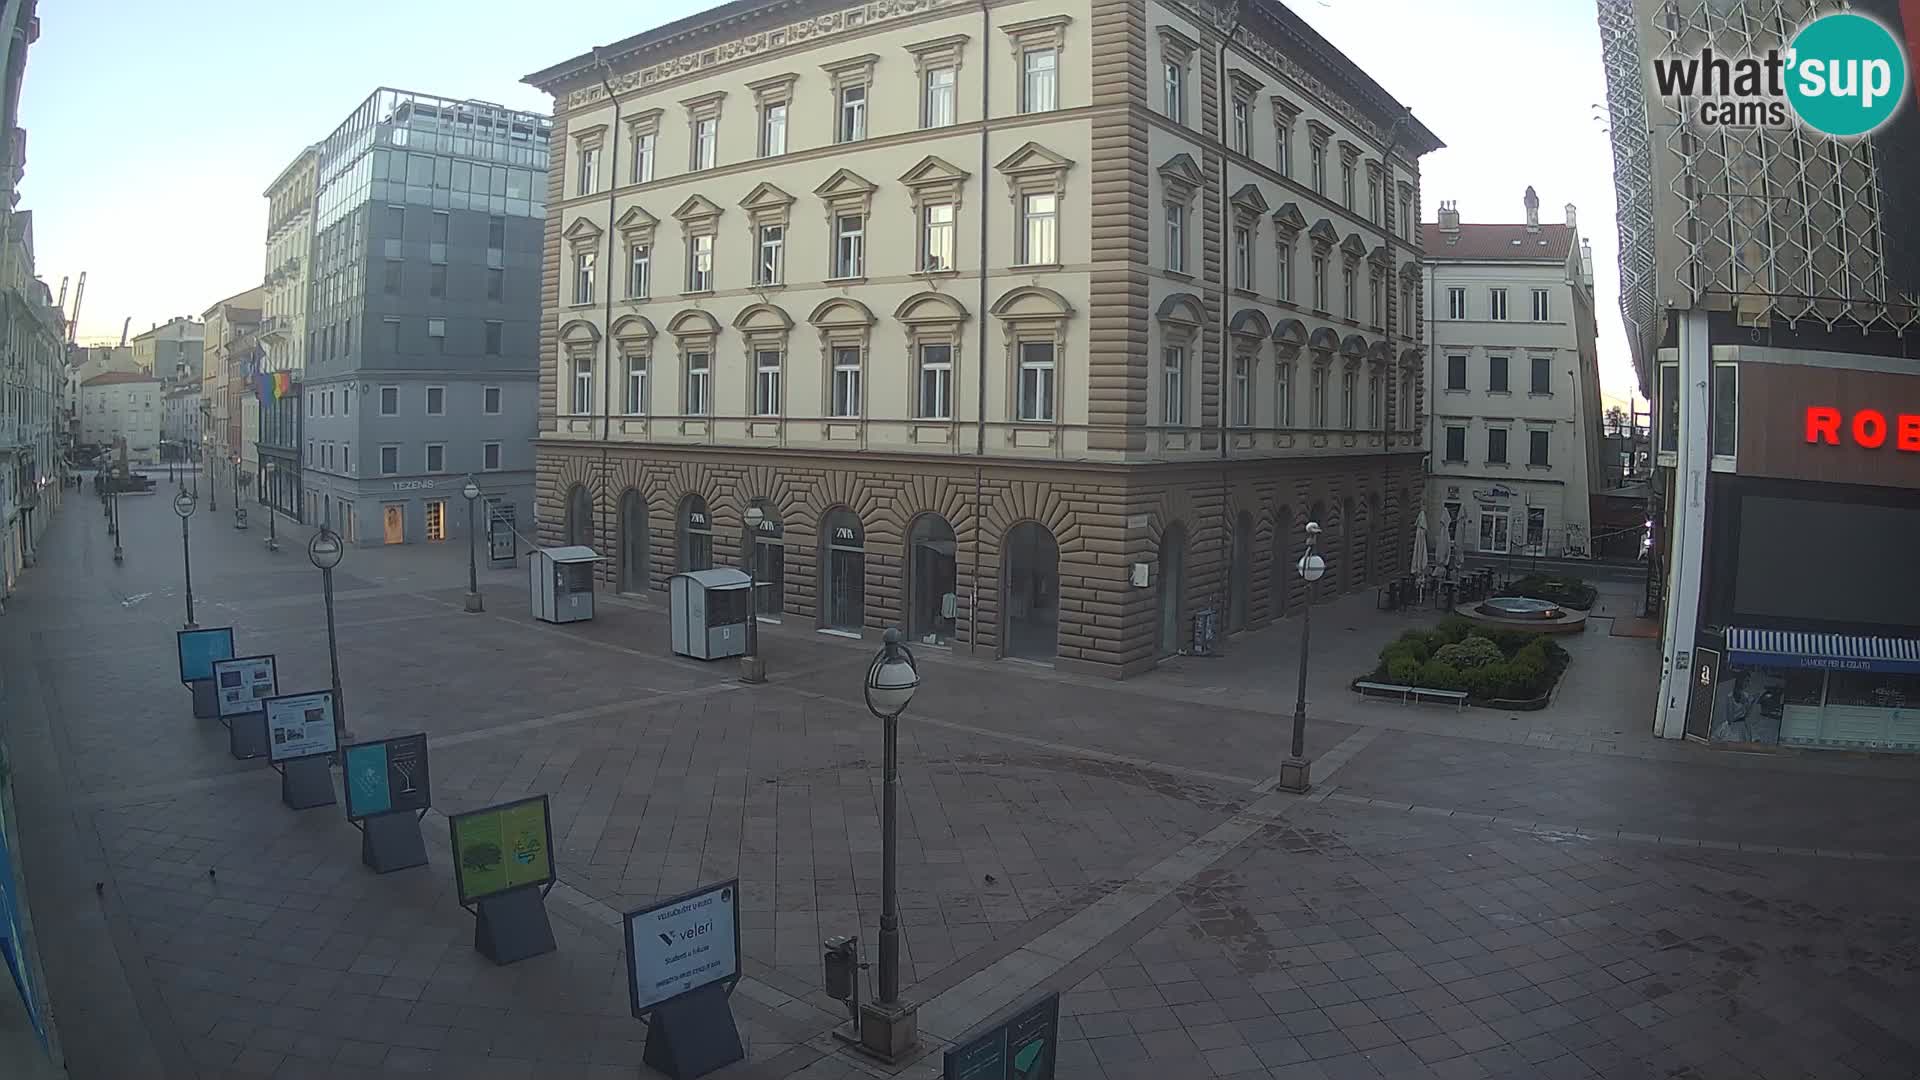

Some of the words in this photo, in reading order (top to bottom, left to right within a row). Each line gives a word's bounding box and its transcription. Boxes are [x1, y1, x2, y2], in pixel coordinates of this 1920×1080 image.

[1806, 406, 1920, 451] ROB
[392, 480, 434, 491] TEZENIS
[836, 527, 854, 539] ZARA
[679, 919, 713, 940] veleri
